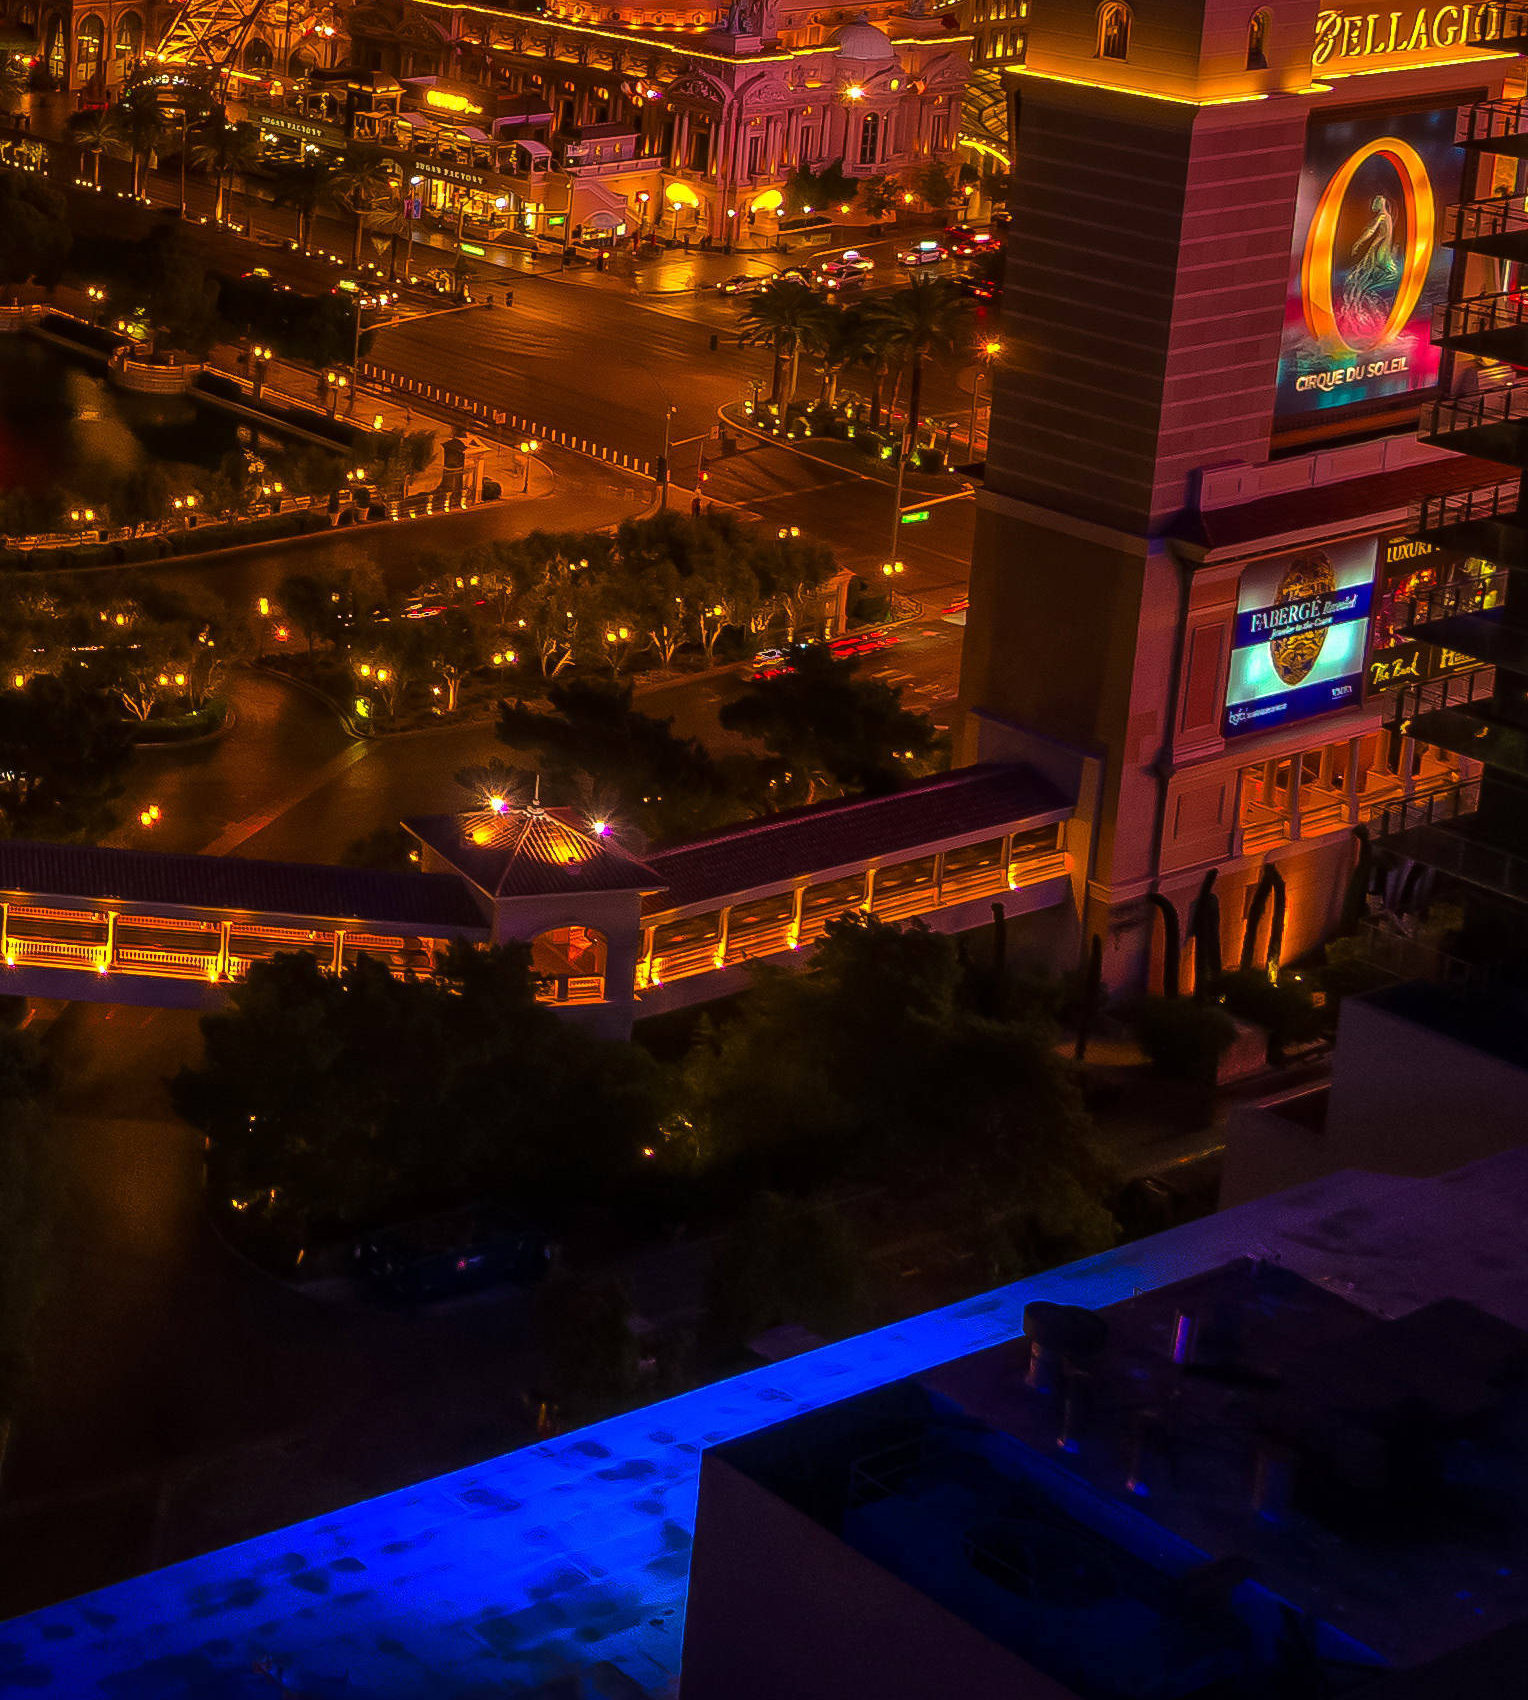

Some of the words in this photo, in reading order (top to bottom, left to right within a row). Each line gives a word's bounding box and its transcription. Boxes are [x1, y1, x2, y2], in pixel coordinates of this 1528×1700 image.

[1311, 1, 1498, 67] BELLAGIO
[415, 161, 442, 174] SUGAR
[443, 168, 484, 185] FACTORY
[1295, 369, 1345, 392] CIRQUE
[1346, 365, 1365, 383] DU
[1366, 356, 1410, 378] SOLEIL
[1250, 596, 1322, 633] FABERGÉ
